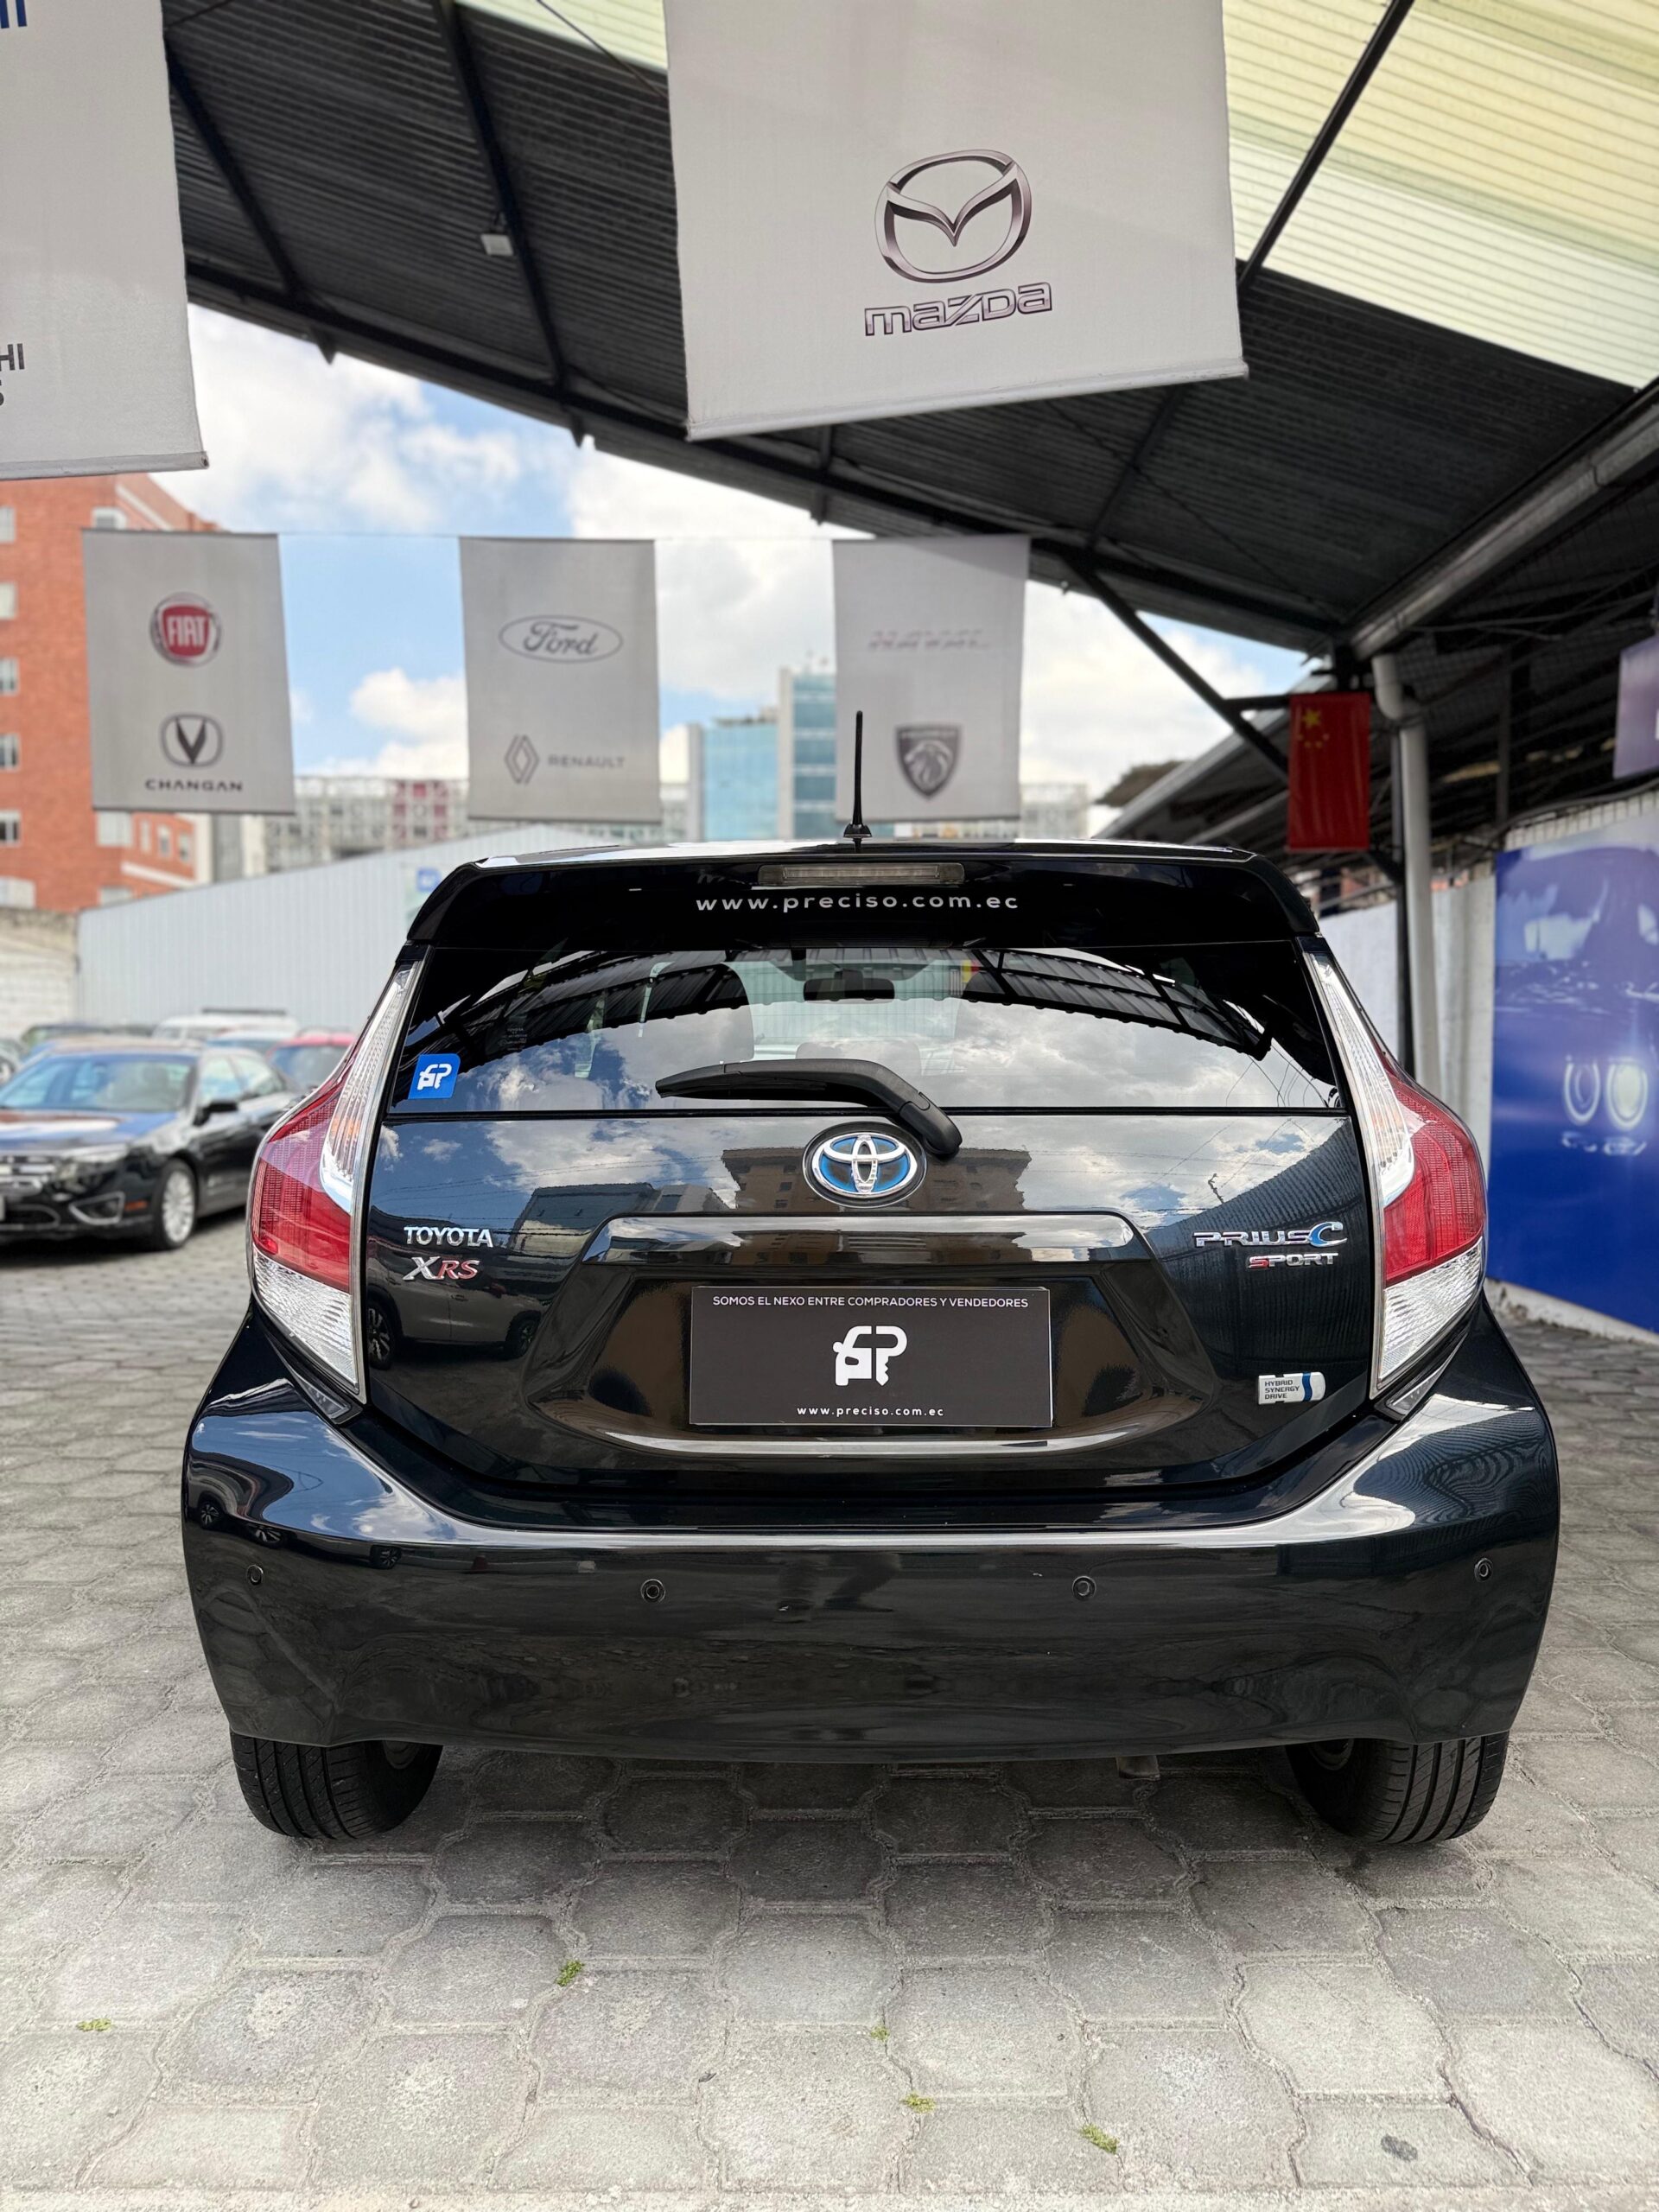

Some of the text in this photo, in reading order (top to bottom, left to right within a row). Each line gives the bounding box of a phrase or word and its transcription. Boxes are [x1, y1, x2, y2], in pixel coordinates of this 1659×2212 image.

[167, 615, 207, 647] FIAT
[524, 620, 599, 655] Ford
[547, 754, 625, 768] RENAULT
[144, 779, 243, 792] CHANGAN
[696, 893, 1018, 913] www.preciso.com.ec
[404, 1226, 493, 1248] TOYOTA
[402, 1255, 480, 1281] XRS
[1248, 1252, 1338, 1268] SPORT
[713, 1296, 1029, 1307] SOMOS EL NEXO ENTRE COMPRADORES Y VENDEDORES
[797, 1406, 944, 1418] www.preciso.com.ec
